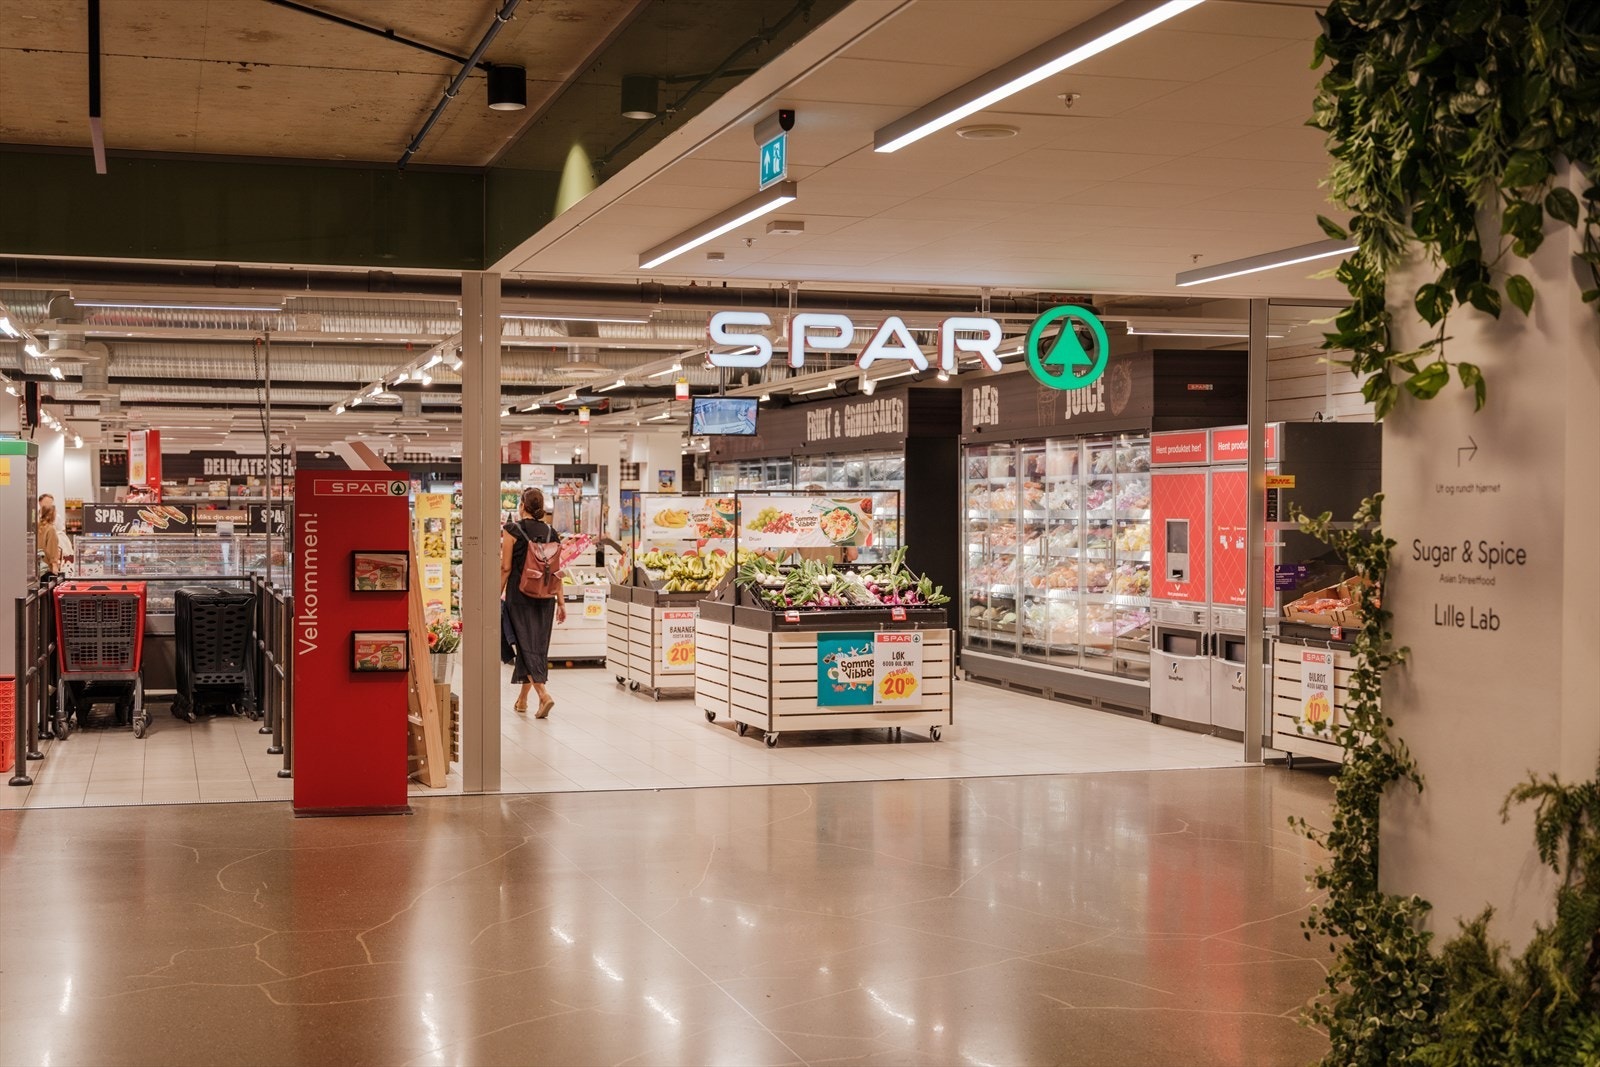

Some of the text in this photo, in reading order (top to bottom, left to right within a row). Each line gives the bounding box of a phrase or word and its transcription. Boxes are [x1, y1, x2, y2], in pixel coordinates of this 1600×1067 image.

[706, 310, 1003, 372] SPAR
[972, 385, 999, 426] BÆR
[1065, 370, 1106, 420] JUICE
[806, 407, 832, 442] FRUKT
[834, 410, 841, 438] &
[1156, 443, 1202, 455] Hent produktet her!
[1218, 442, 1231, 451] Hent
[332, 483, 387, 493] SPAR
[1446, 486, 1455, 496] og
[94, 508, 124, 524] SPAR
[1412, 538, 1527, 570] Sugar & Spice
[298, 512, 318, 655] Velkommen!
[1434, 603, 1501, 631] Lille Lab
[892, 651, 905, 660] LØK
[1306, 653, 1325, 662] SPAR
